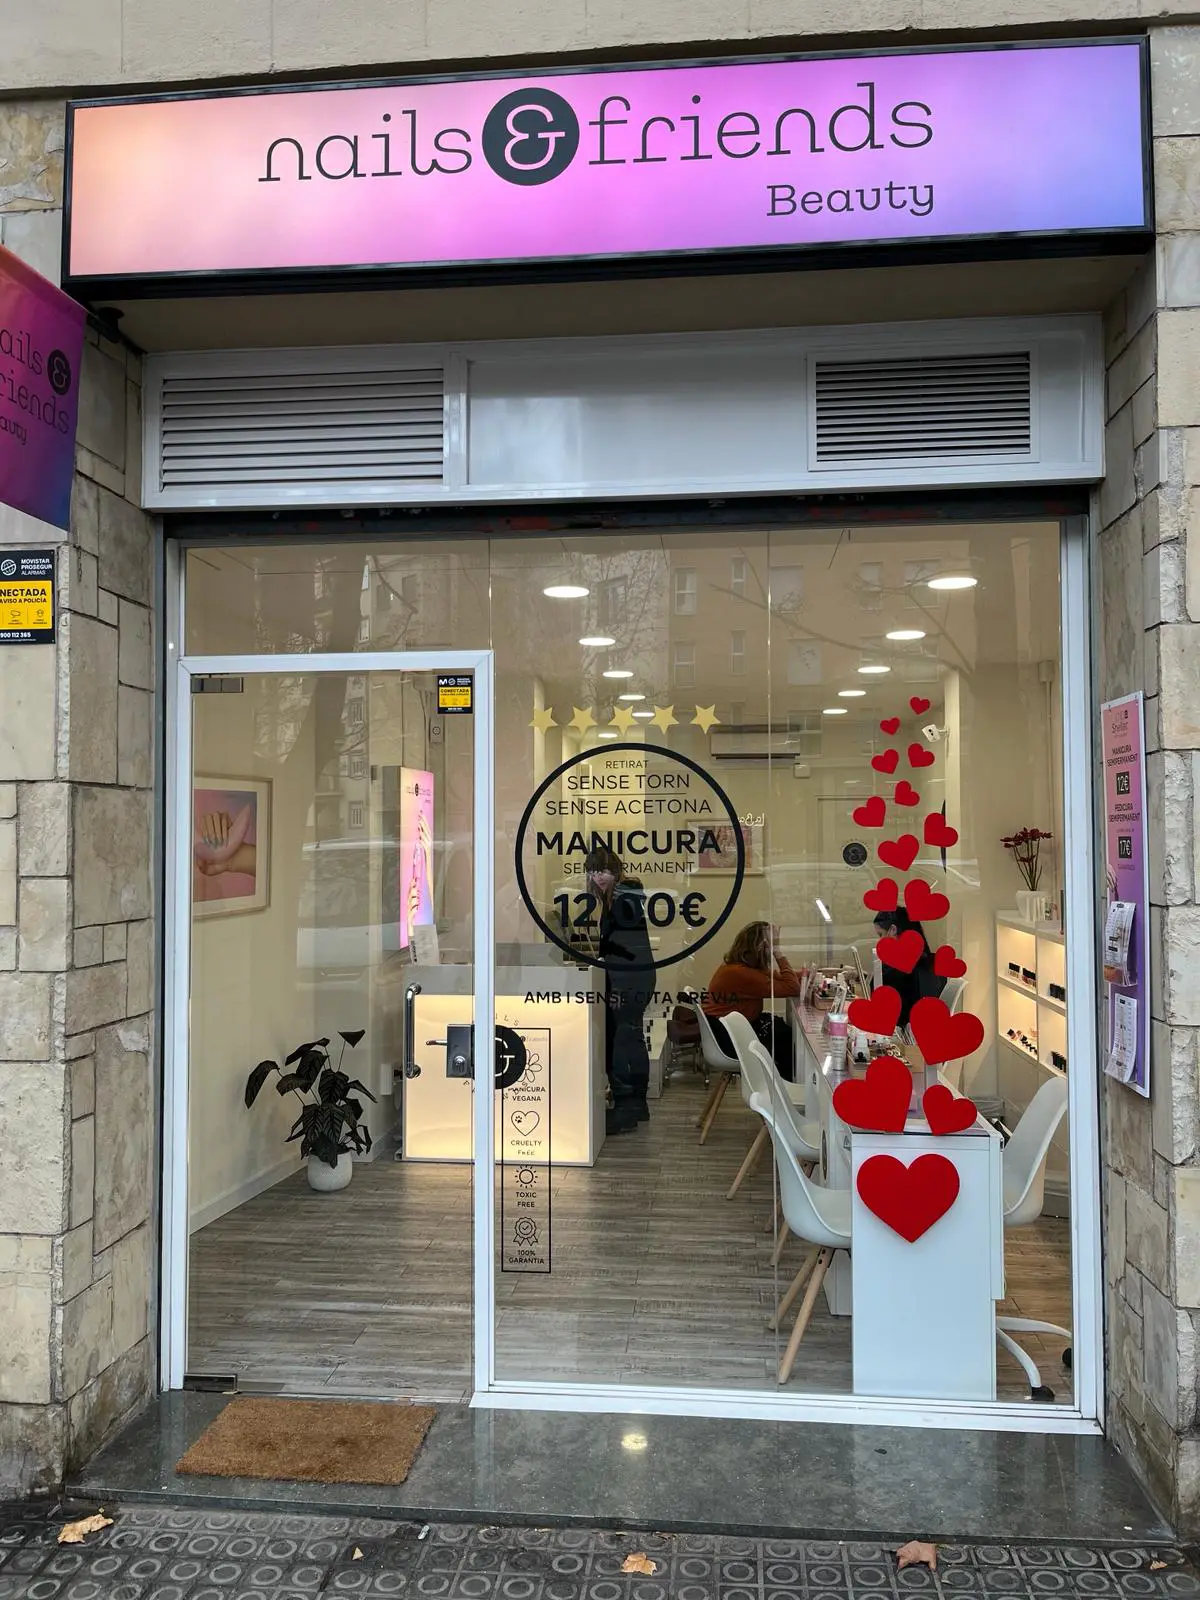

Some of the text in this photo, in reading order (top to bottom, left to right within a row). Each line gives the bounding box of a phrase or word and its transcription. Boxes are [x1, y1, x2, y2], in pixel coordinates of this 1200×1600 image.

[258, 82, 934, 182] nails & friends
[766, 181, 934, 216] Beauty
[605, 760, 649, 769] RETIRAT
[567, 774, 690, 790] SENSE TORN
[1117, 775, 1129, 792] 12€
[546, 798, 712, 816] SENSE ACETONA
[536, 830, 721, 856] MANICURA
[1120, 839, 1131, 856] 17€
[553, 892, 707, 928] 1200€
[524, 991, 561, 1004] AMB
[566, 991, 570, 1003] I
[575, 991, 628, 1004] SENSE
[634, 991, 672, 1003] CITA
